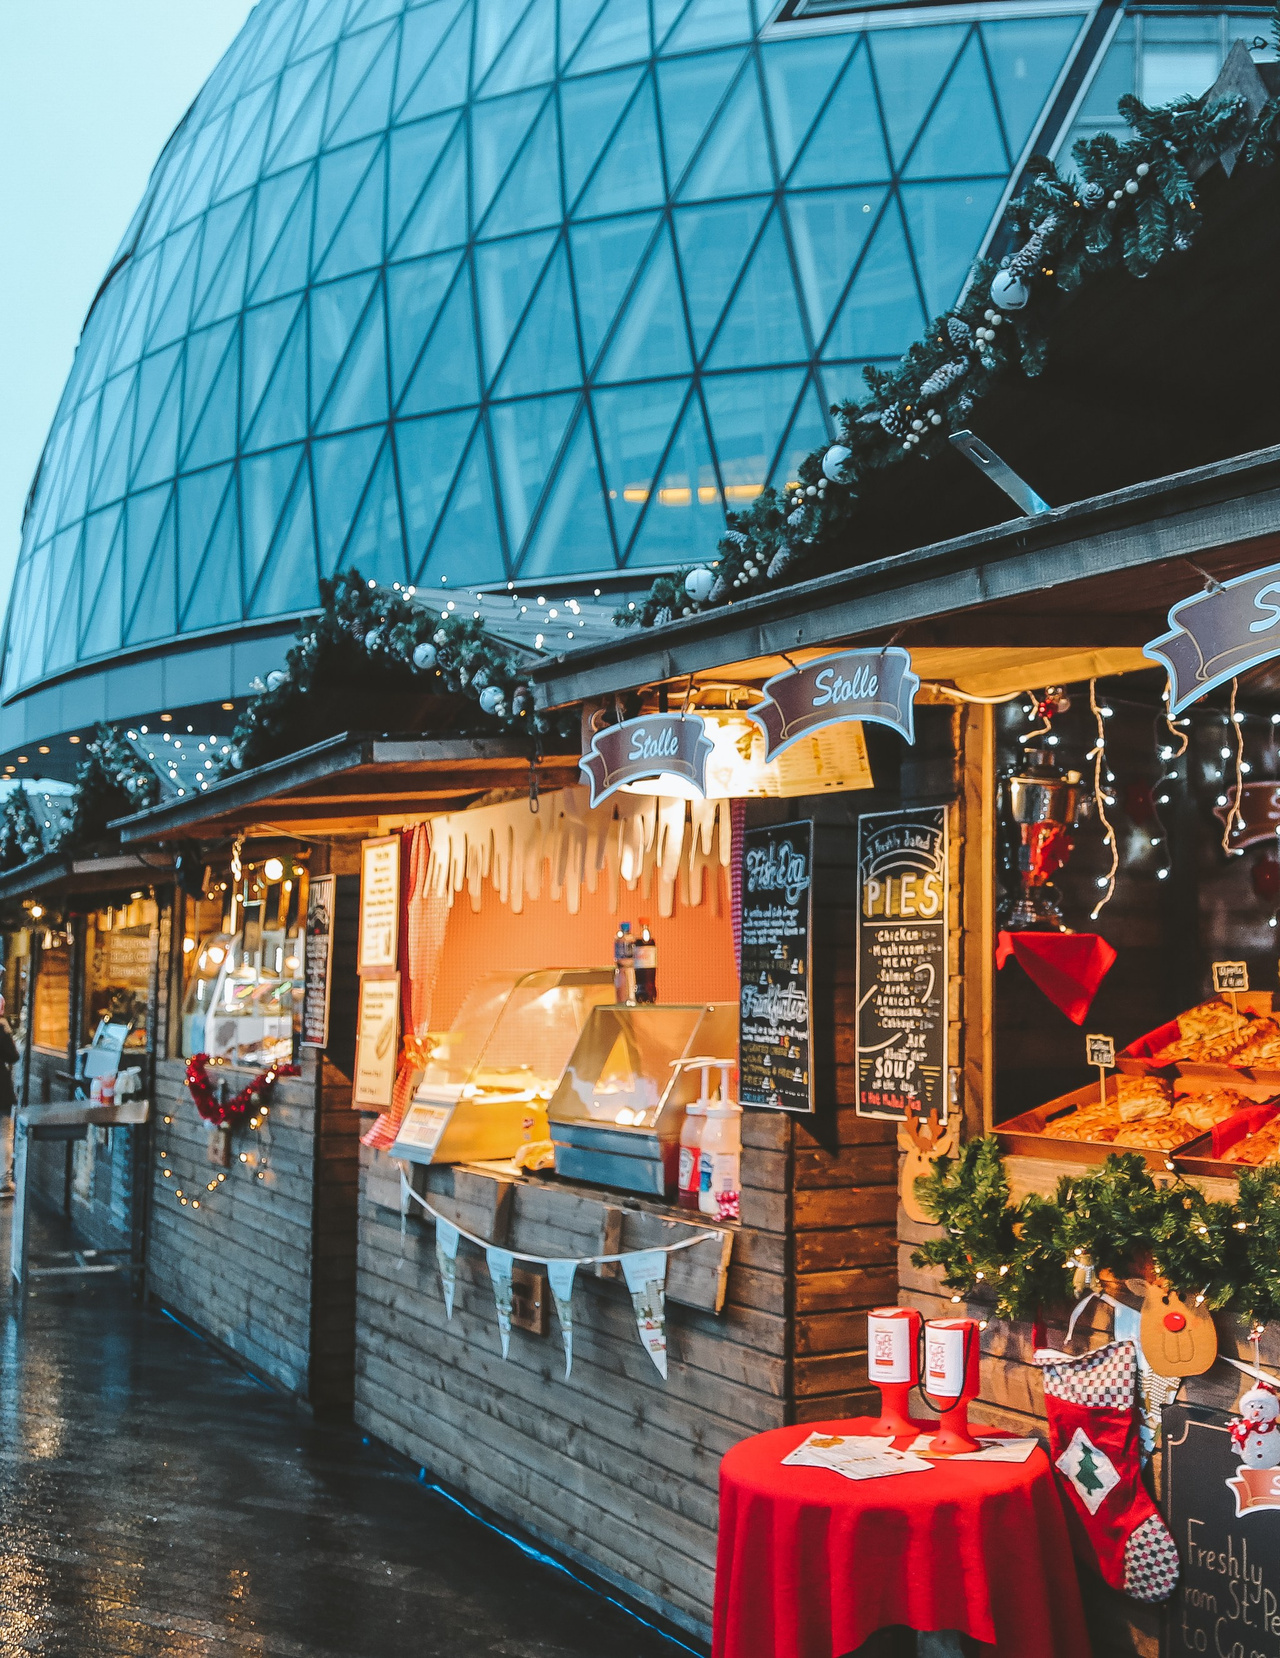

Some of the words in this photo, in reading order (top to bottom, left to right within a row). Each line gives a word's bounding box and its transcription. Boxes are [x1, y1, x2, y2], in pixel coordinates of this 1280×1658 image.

[812, 664, 880, 707] Stolle
[628, 726, 679, 761] Stolle
[867, 873, 940, 917] PIES
[872, 942, 925, 956] Mushroom
[882, 956, 913, 968] MEAT
[875, 1056, 916, 1080] SOUP
[1187, 1518, 1263, 1604] Freshly
[1181, 1610, 1208, 1651] to
